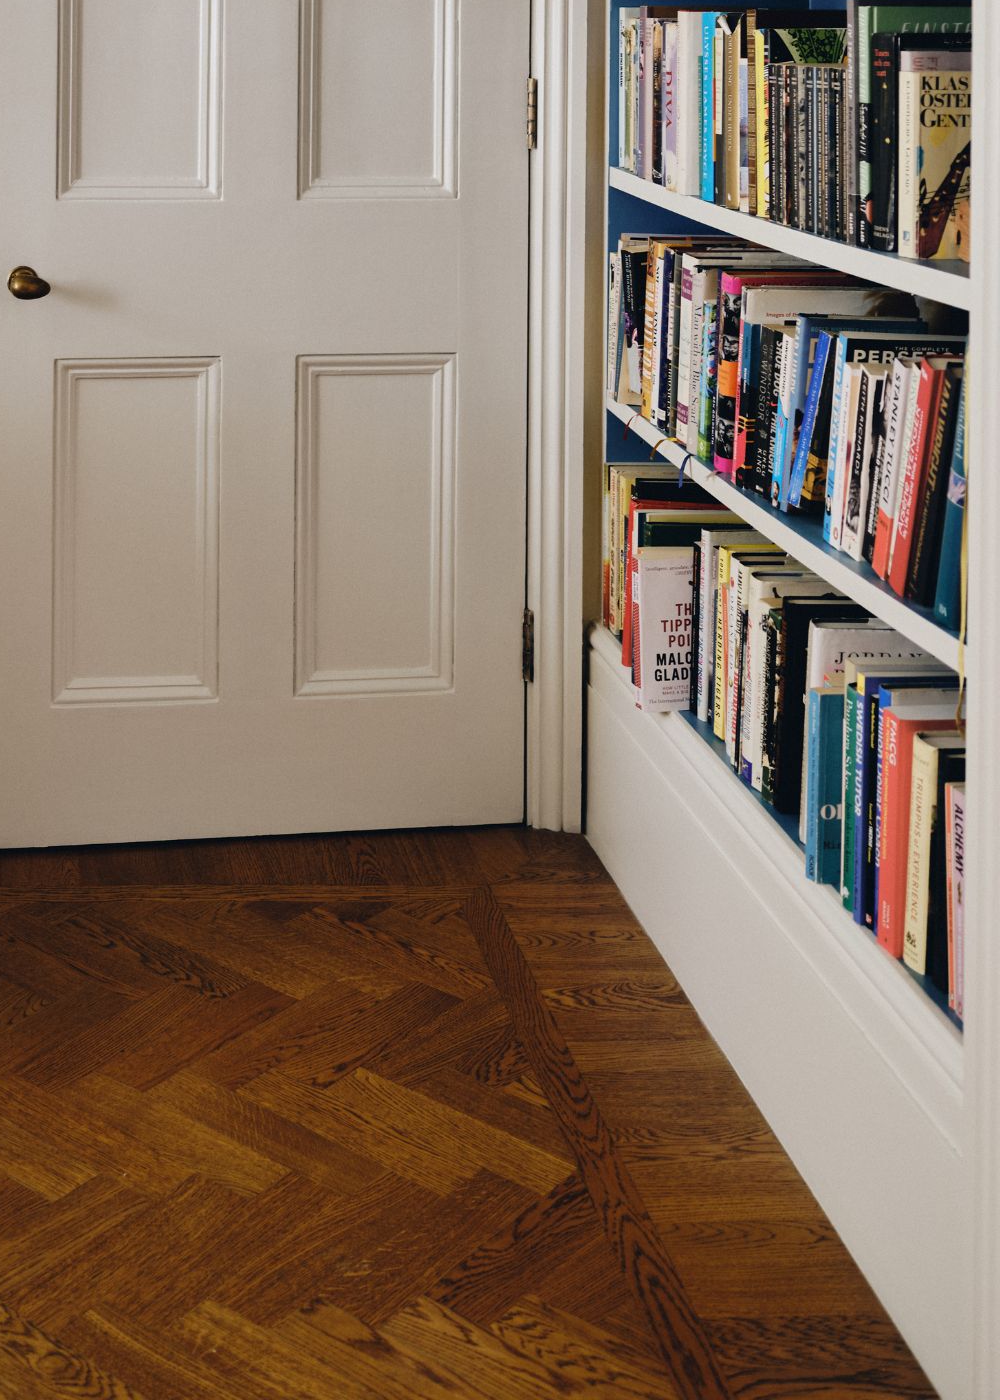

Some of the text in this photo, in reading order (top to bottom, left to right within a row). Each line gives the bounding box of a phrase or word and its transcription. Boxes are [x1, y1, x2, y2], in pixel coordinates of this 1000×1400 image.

[921, 76, 969, 91] KLAS
[694, 304, 702, 330] Man
[693, 334, 701, 356] with
[774, 340, 783, 372] SHOE
[691, 369, 701, 392] Blue
[758, 344, 768, 420] OF WINDSOR
[772, 372, 781, 396] DOG
[940, 376, 952, 415] IAN
[690, 396, 699, 426] Scarf
[854, 375, 868, 474] KEITH RICHARDS
[767, 436, 776, 473] KNIGHT
[882, 373, 901, 504] STANLEY TUCCI
[927, 416, 945, 491] WRIGHT
[660, 619, 692, 632] TIPP
[675, 603, 692, 616] TH
[668, 634, 690, 648] POI
[654, 668, 689, 682] GLAD
[855, 699, 864, 763] SWEDISH
[888, 719, 898, 765] FMCG
[854, 767, 862, 816] TUTOR
[914, 777, 924, 836] TRIUMPHS
[954, 804, 964, 877] ALCHEMY
[910, 850, 920, 920] EXPERIENCE
